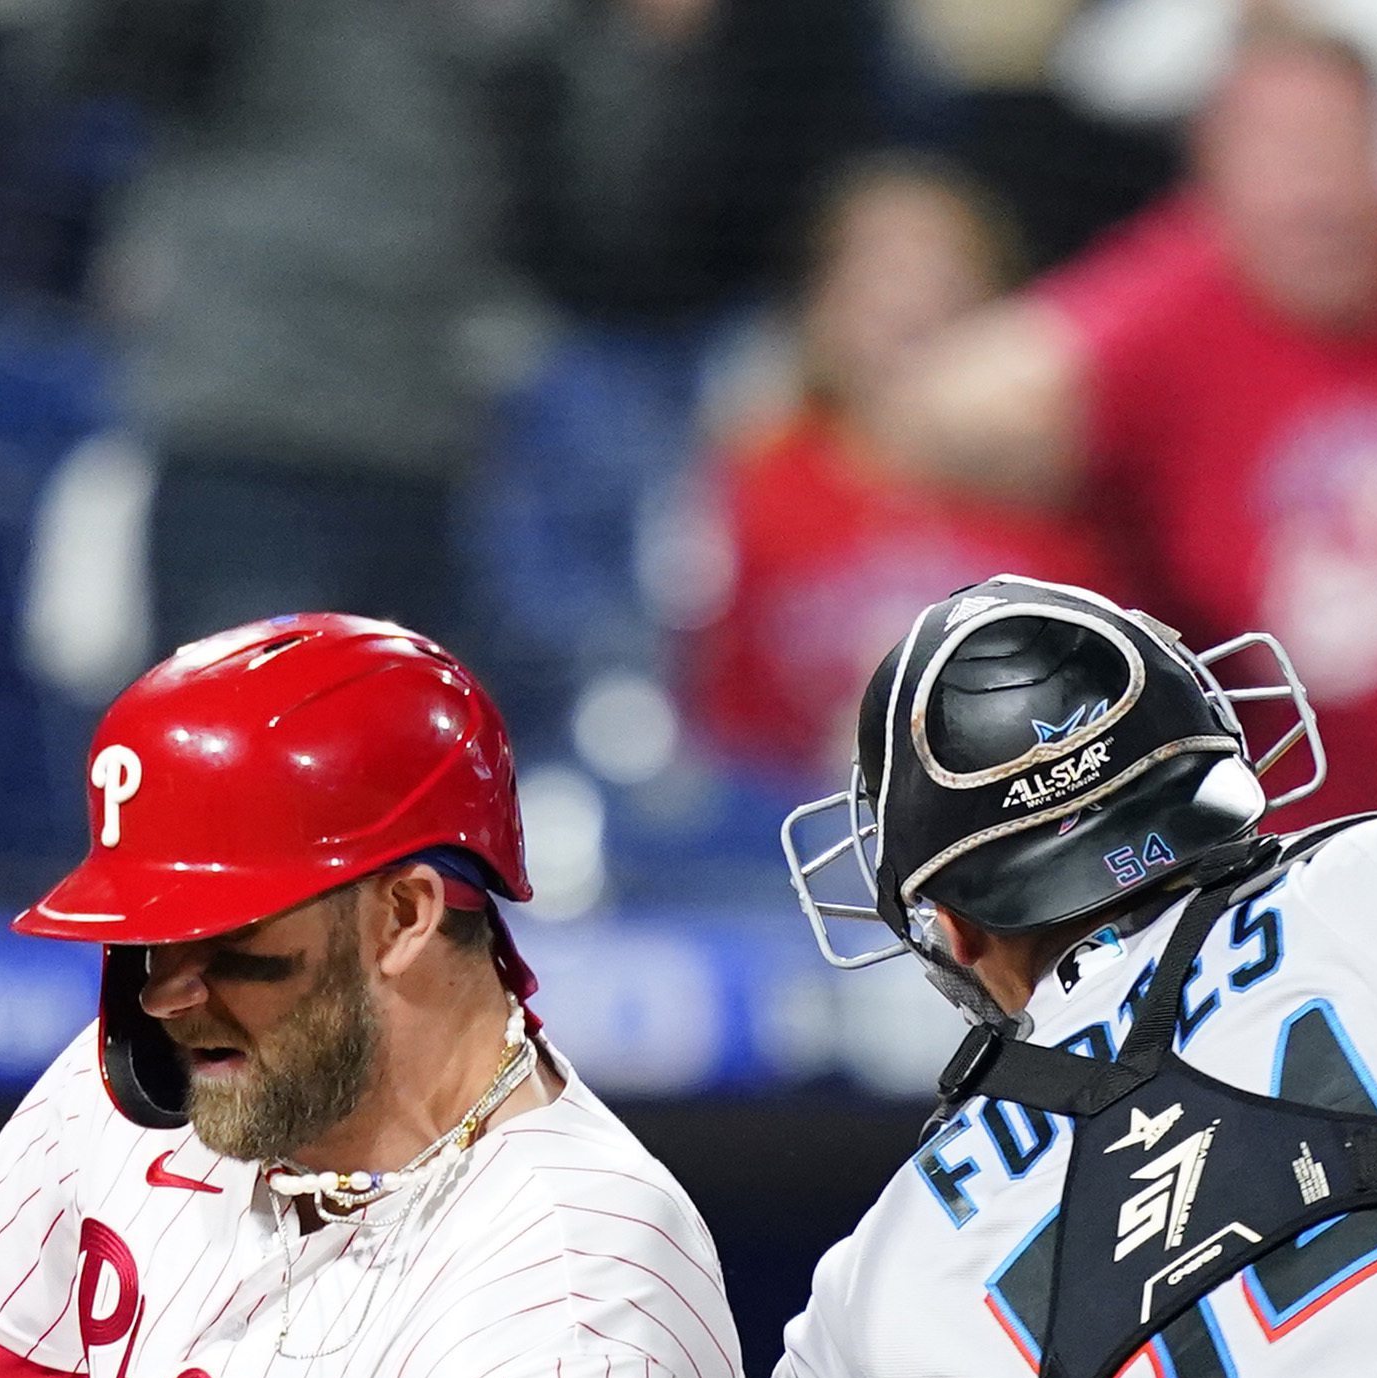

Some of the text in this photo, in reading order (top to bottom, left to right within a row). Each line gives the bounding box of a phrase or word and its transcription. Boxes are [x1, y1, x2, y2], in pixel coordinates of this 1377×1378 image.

[90, 744, 142, 847] P
[1002, 740, 1111, 808] ALL-STAR
[1103, 832, 1176, 888] 54
[912, 876, 1284, 1230] FOES
